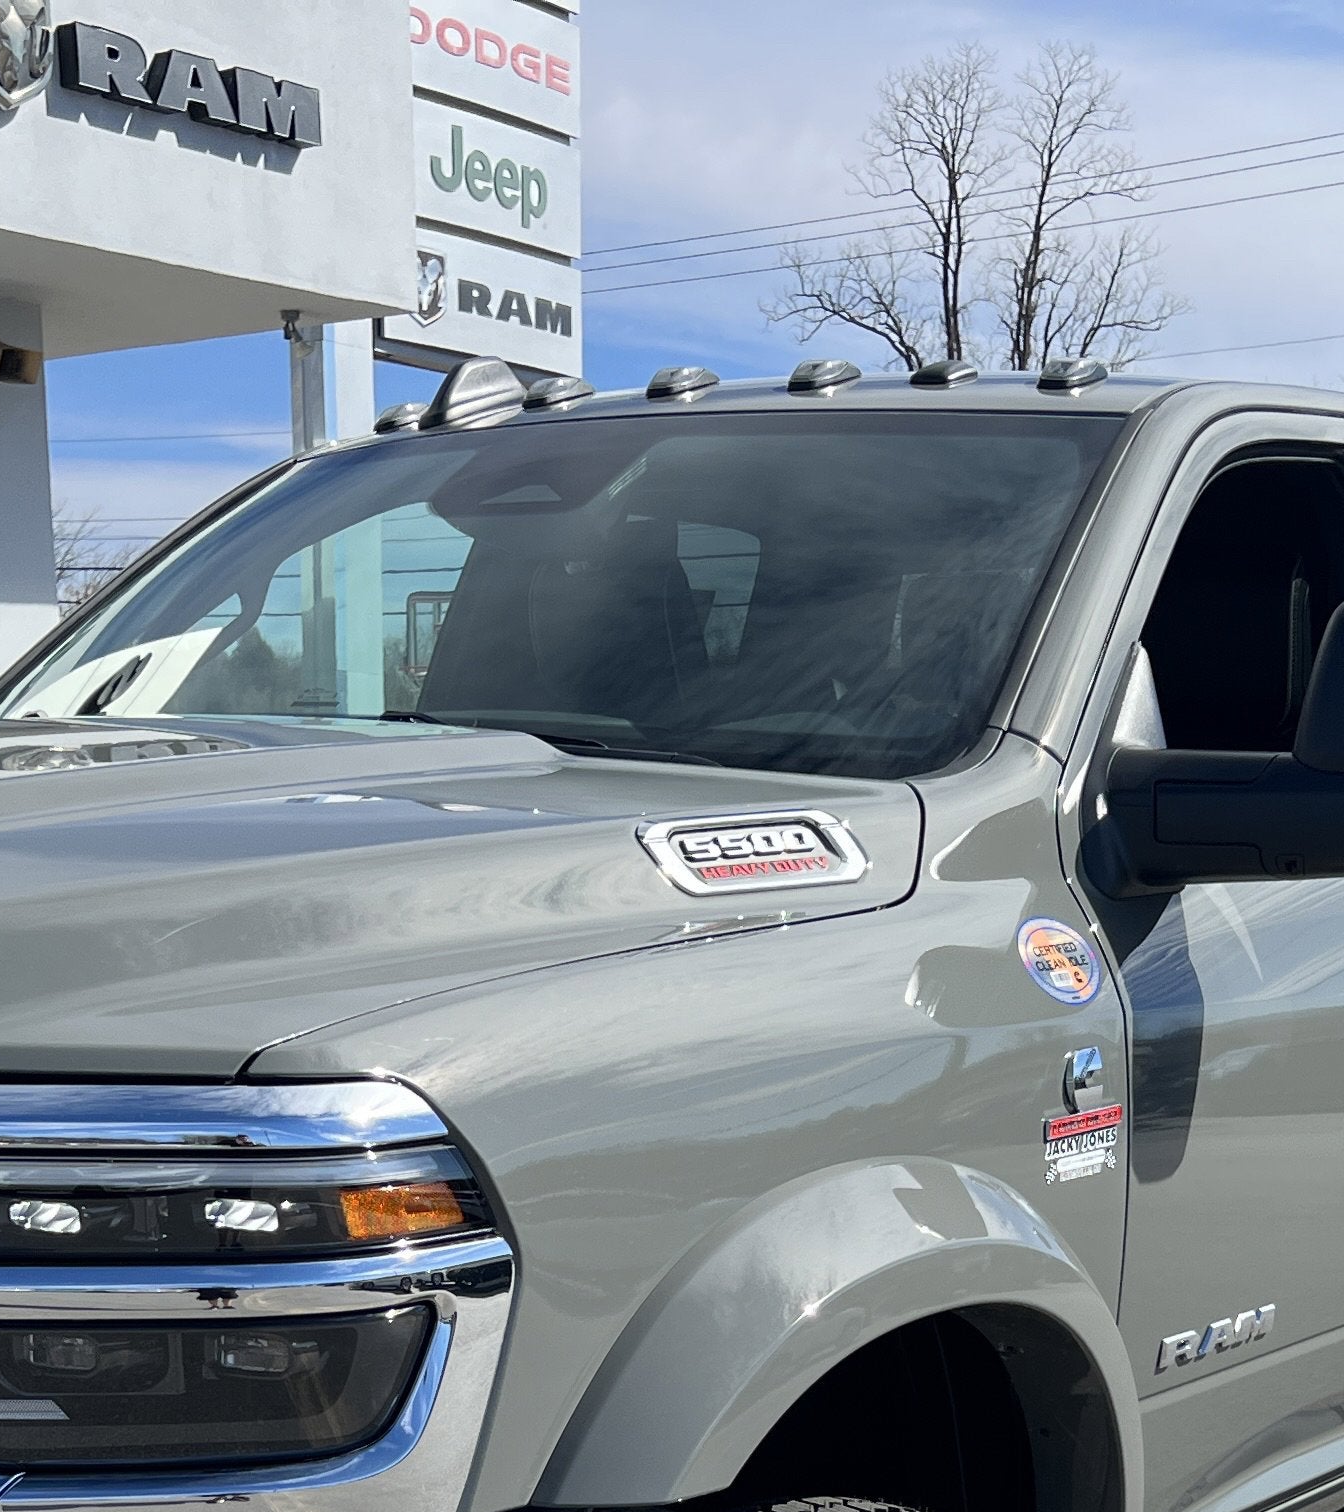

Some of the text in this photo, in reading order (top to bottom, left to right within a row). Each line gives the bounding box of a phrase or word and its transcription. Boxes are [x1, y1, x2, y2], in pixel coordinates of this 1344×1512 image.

[409, 6, 571, 96] DODGE
[56, 21, 322, 148] RAM
[430, 124, 548, 229] Jeep
[458, 279, 572, 338] RAM
[678, 829, 817, 862] 5500
[697, 856, 829, 881] HEAVY DUTY
[1033, 942, 1077, 957] CERTIFIED
[1036, 958, 1067, 971] CLEAN
[1046, 1128, 1117, 1159] JACKY JONES
[1155, 1303, 1276, 1373] RAM
